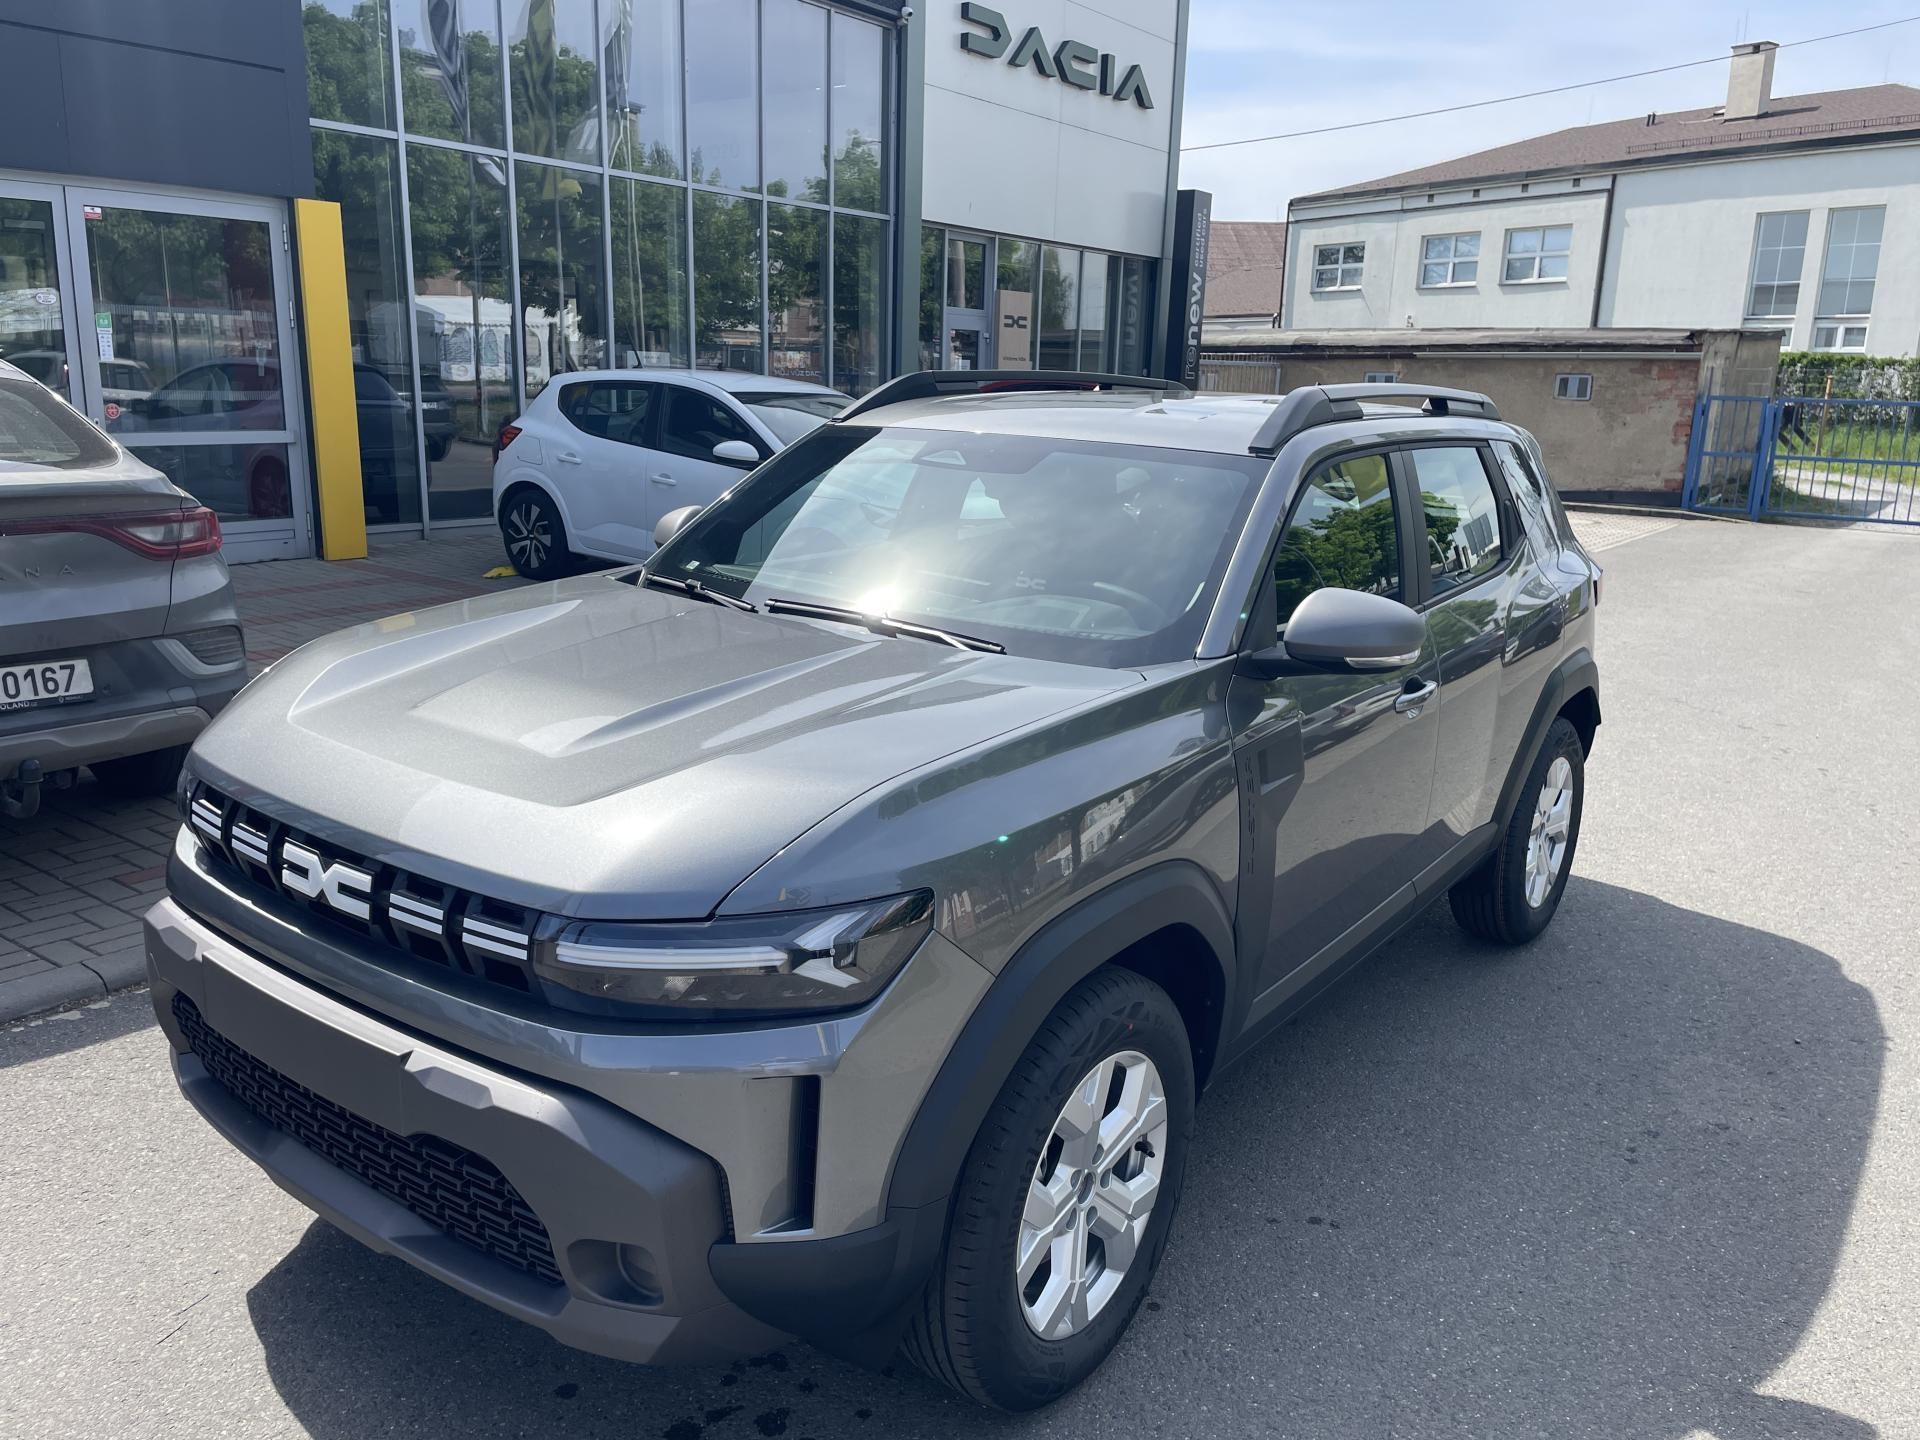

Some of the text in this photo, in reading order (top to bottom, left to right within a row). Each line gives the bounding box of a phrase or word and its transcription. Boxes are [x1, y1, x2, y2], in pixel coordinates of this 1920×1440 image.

[960, 1, 1154, 109] DACIA
[1194, 212, 1202, 267] certified
[1184, 271, 1202, 380] renew
[0, 700, 31, 711] OLAND
[1, 663, 77, 699] 0167
